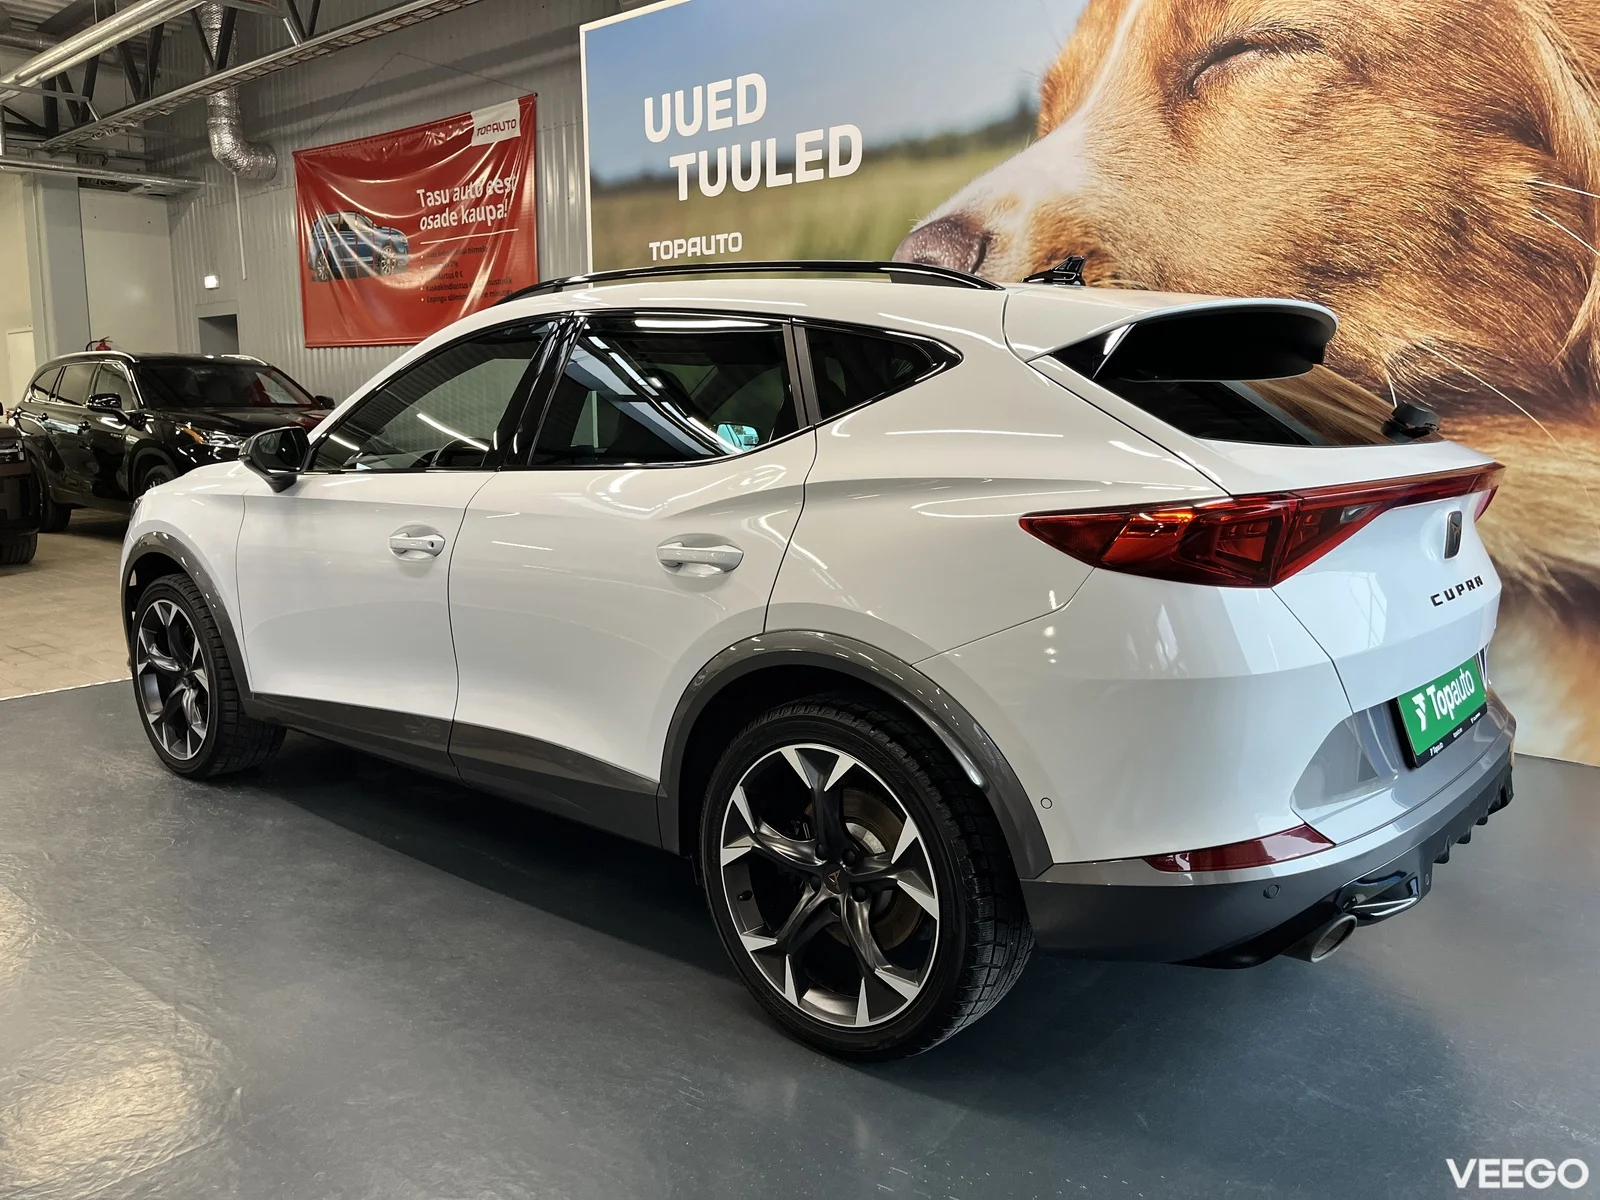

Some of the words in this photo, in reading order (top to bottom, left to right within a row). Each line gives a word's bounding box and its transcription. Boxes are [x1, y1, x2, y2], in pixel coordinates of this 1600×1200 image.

[644, 73, 767, 143] UUED
[476, 119, 517, 136] TOPAUTO
[669, 124, 863, 201] TUULED
[416, 188, 450, 208] Tasu
[453, 181, 484, 202] auto
[486, 174, 517, 195] eest
[420, 207, 459, 231] osade
[461, 198, 508, 226] kaupa!
[649, 232, 742, 261] TOPAUTO
[1430, 575, 1484, 607] CUPRA
[1426, 668, 1475, 720] Topauto
